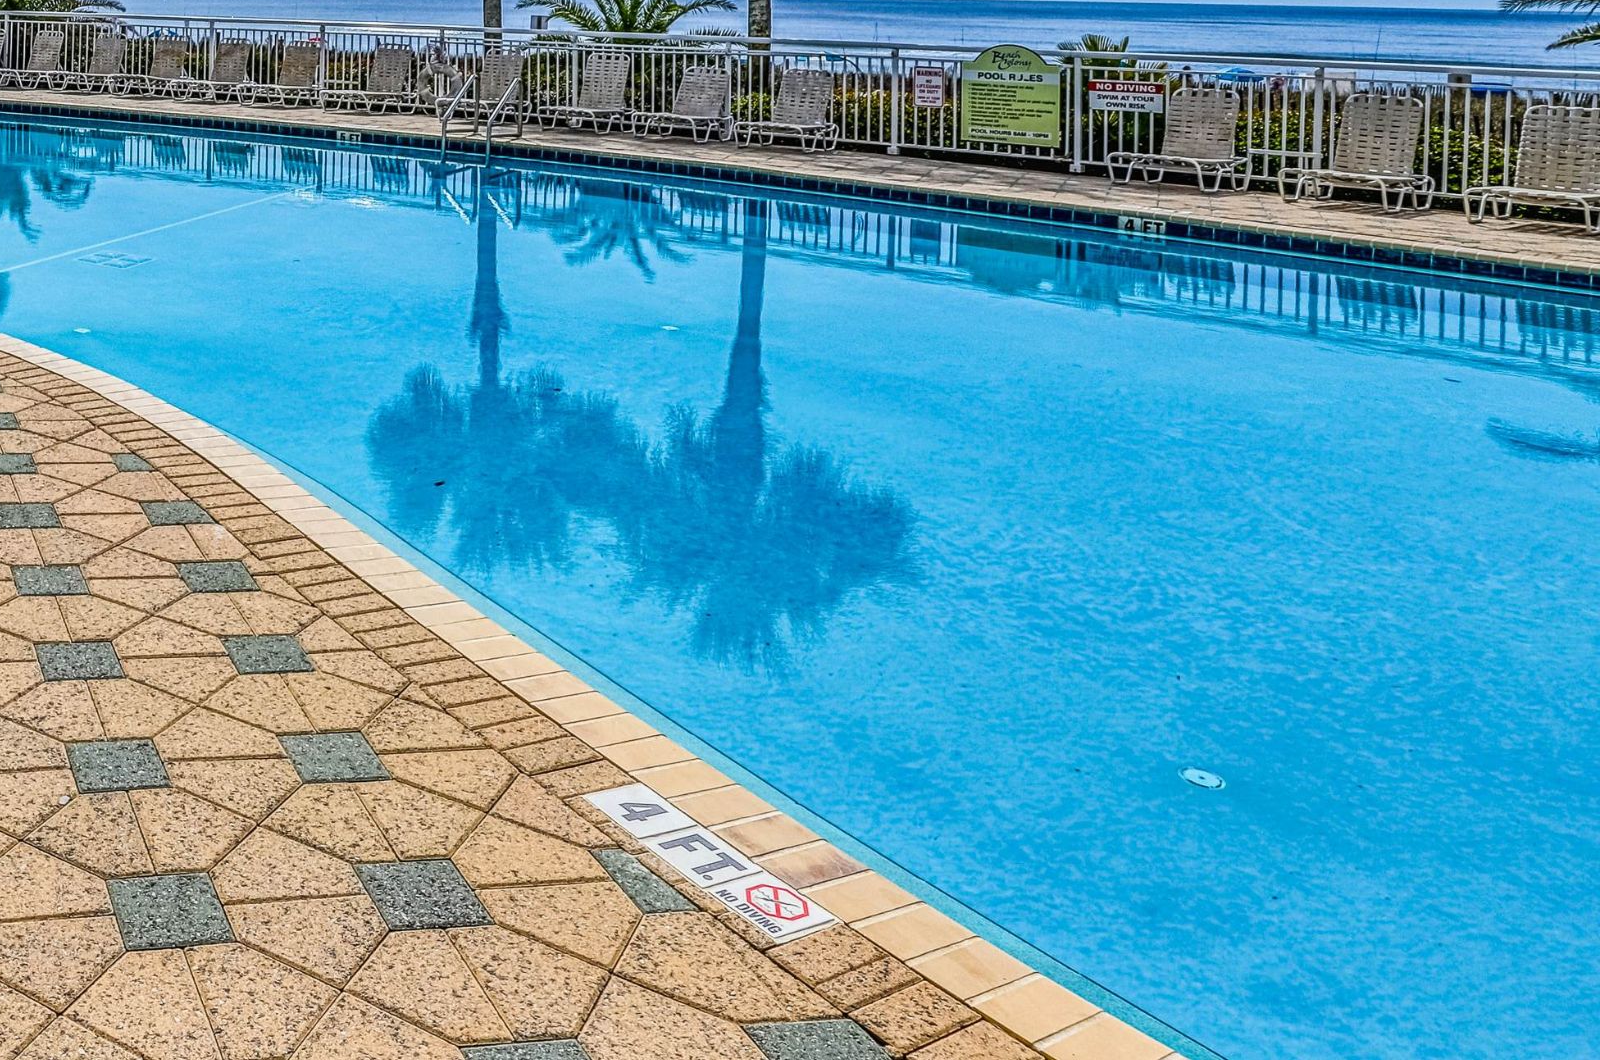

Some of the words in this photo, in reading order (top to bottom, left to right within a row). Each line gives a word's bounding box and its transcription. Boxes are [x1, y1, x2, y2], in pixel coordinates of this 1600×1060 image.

[991, 50, 1021, 63] Beach
[977, 71, 1006, 81] POOL
[1095, 83, 1113, 91] NO
[1115, 84, 1157, 93] DIVING
[1096, 93, 1119, 101] SWIM
[1131, 95, 1155, 103] YOUR
[1105, 101, 1127, 109] OWN
[1128, 102, 1146, 110] RISK
[1124, 218, 1135, 231] 4
[1143, 220, 1164, 235] FT
[619, 802, 669, 822] 4
[658, 833, 747, 881] FT.
[715, 889, 738, 903] NO
[735, 903, 782, 934] DIVING
